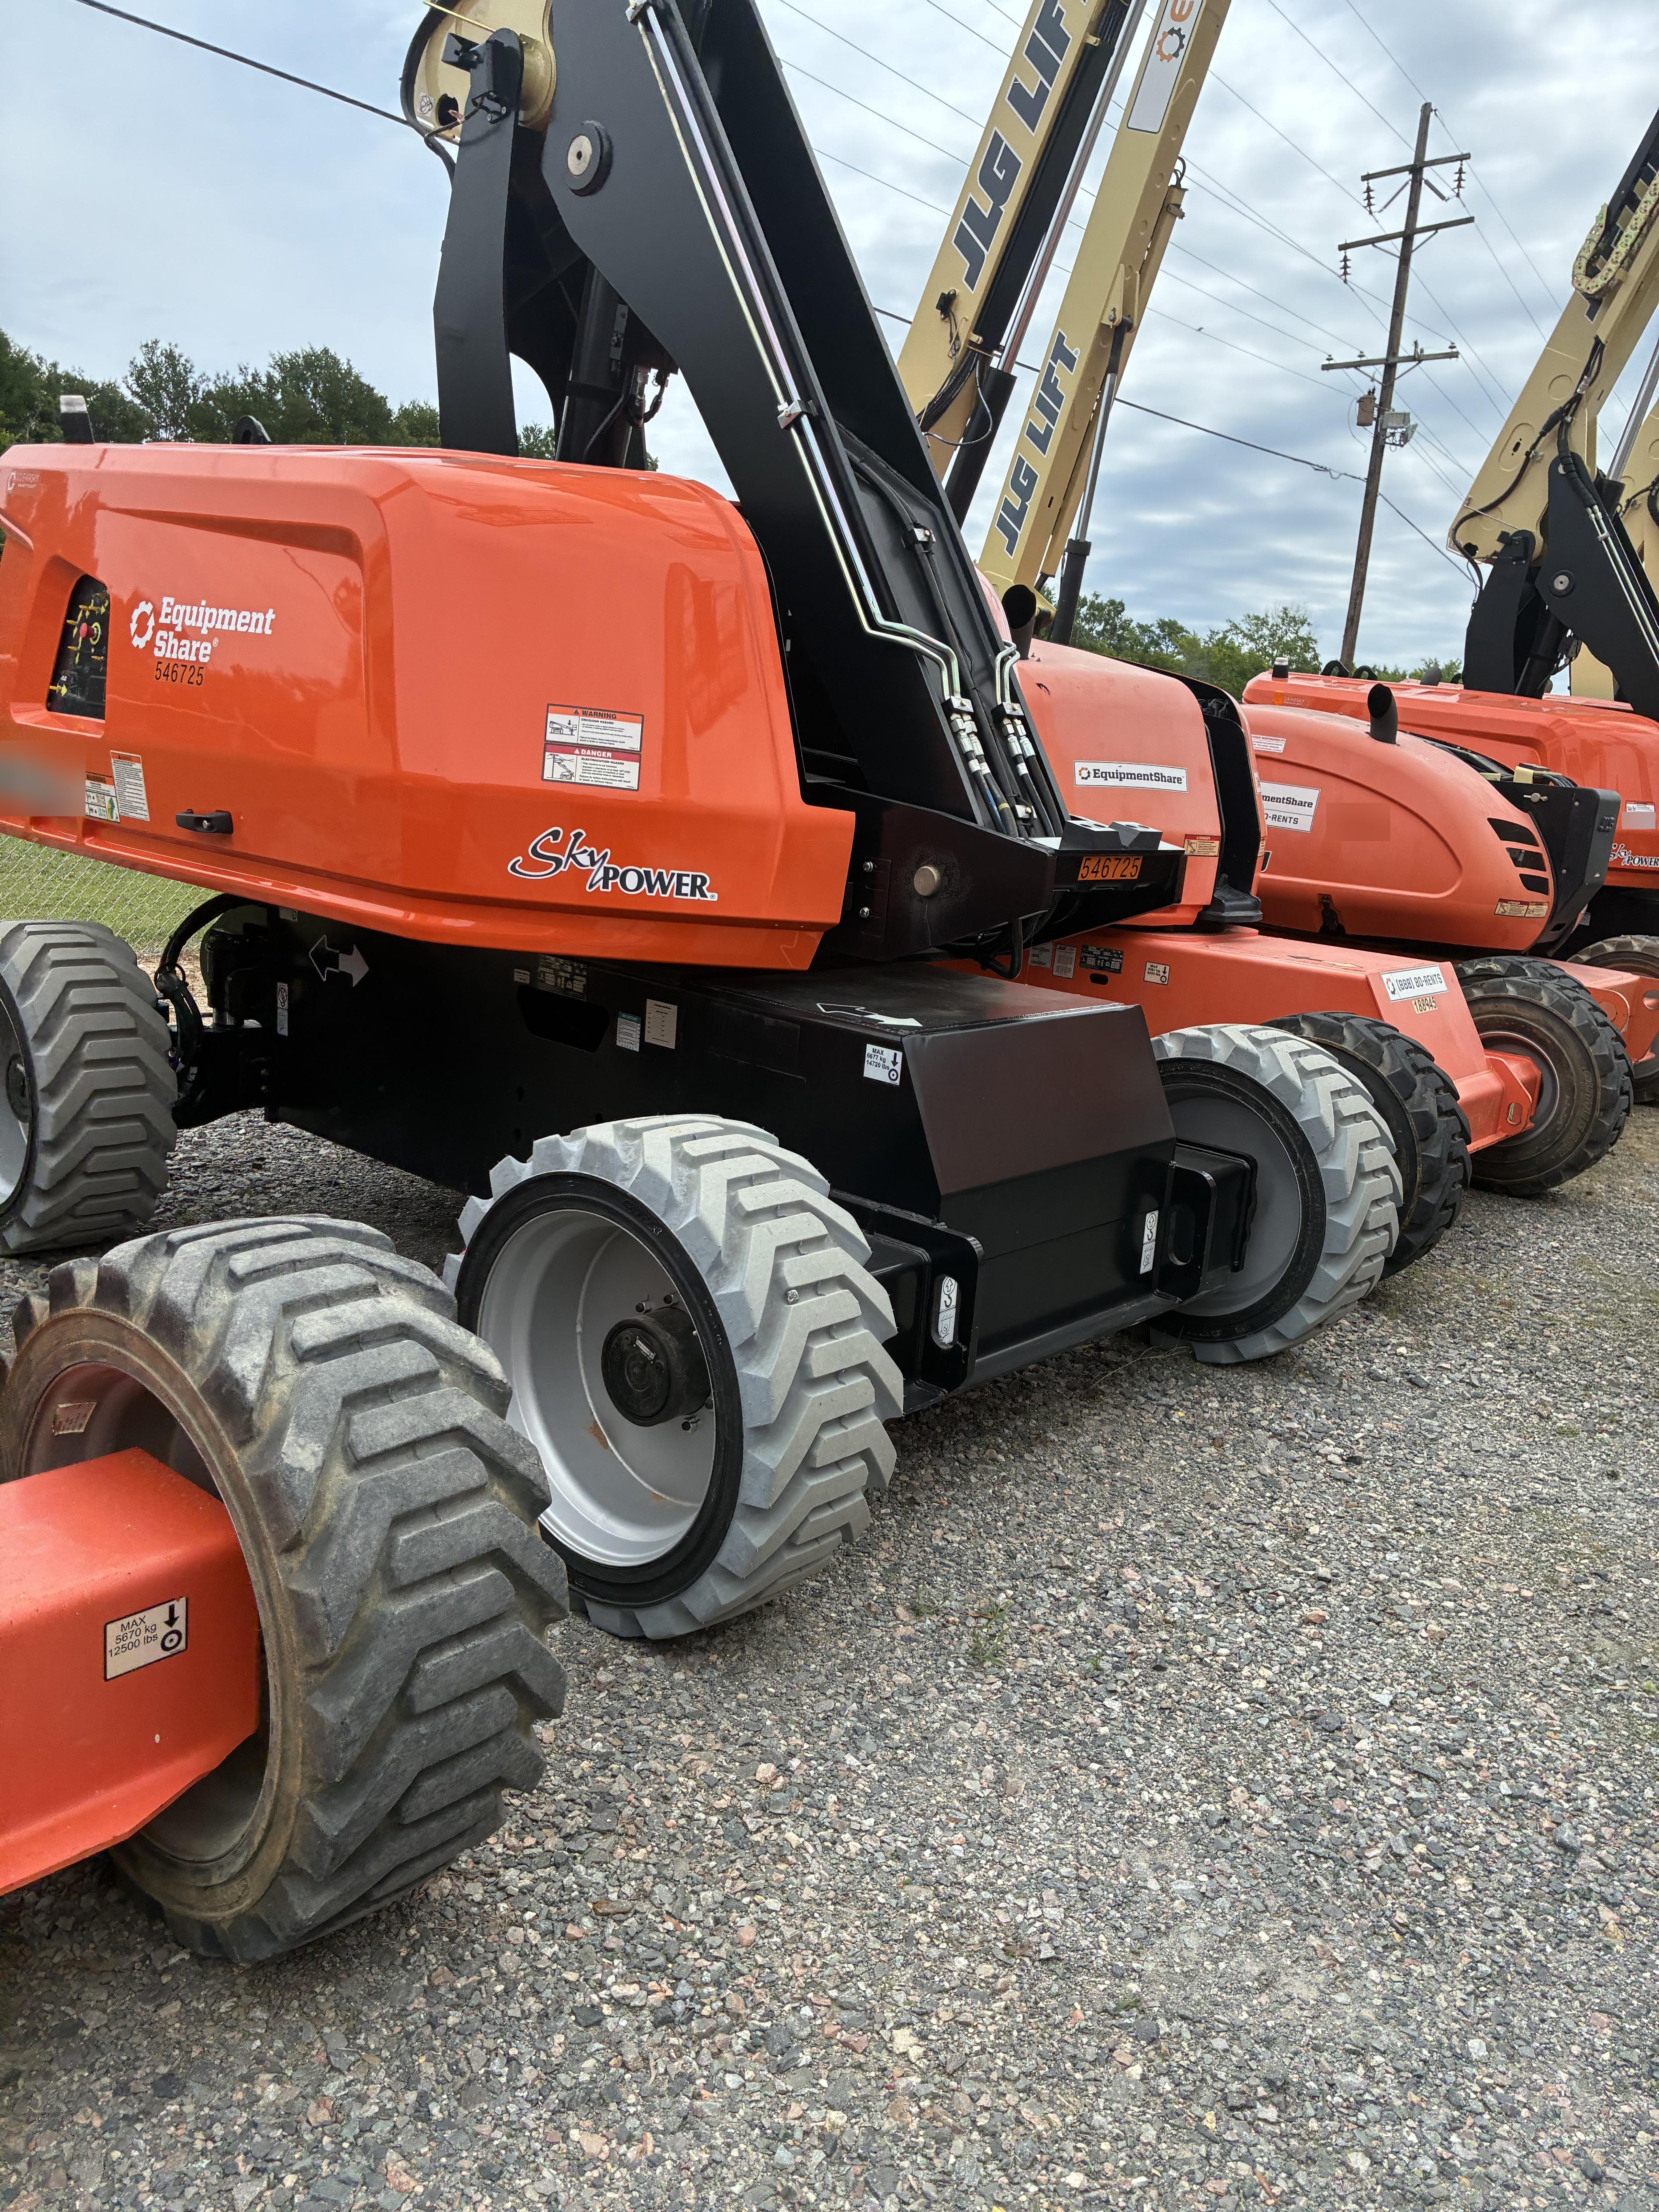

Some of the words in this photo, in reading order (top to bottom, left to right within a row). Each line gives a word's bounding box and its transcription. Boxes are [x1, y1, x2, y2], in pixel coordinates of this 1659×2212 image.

[951, 126, 1024, 294] JLG
[1005, 0, 1089, 136] LIF
[995, 452, 1040, 559] JLG
[1024, 328, 1079, 459] LIFT
[159, 596, 275, 635] Equipment
[155, 661, 204, 686] 546725
[582, 710, 617, 719] WARNING
[581, 749, 612, 758] DANGER
[1092, 769, 1182, 785] EquipmentShare
[1262, 795, 1313, 808] mentShare
[1081, 857, 1141, 879] 546725
[1396, 977, 1415, 992] (888)
[1414, 974, 1443, 988] 80-RENTS
[1414, 996, 1437, 1013] 188945
[872, 1047, 884, 1056] MAX
[867, 1060, 881, 1068] 14720
[121, 1615, 146, 1632] MAX
[115, 1628, 141, 1644] 5670
[145, 1623, 157, 1634] kg
[108, 1638, 140, 1657] 12500
[144, 1634, 158, 1645] lbs
